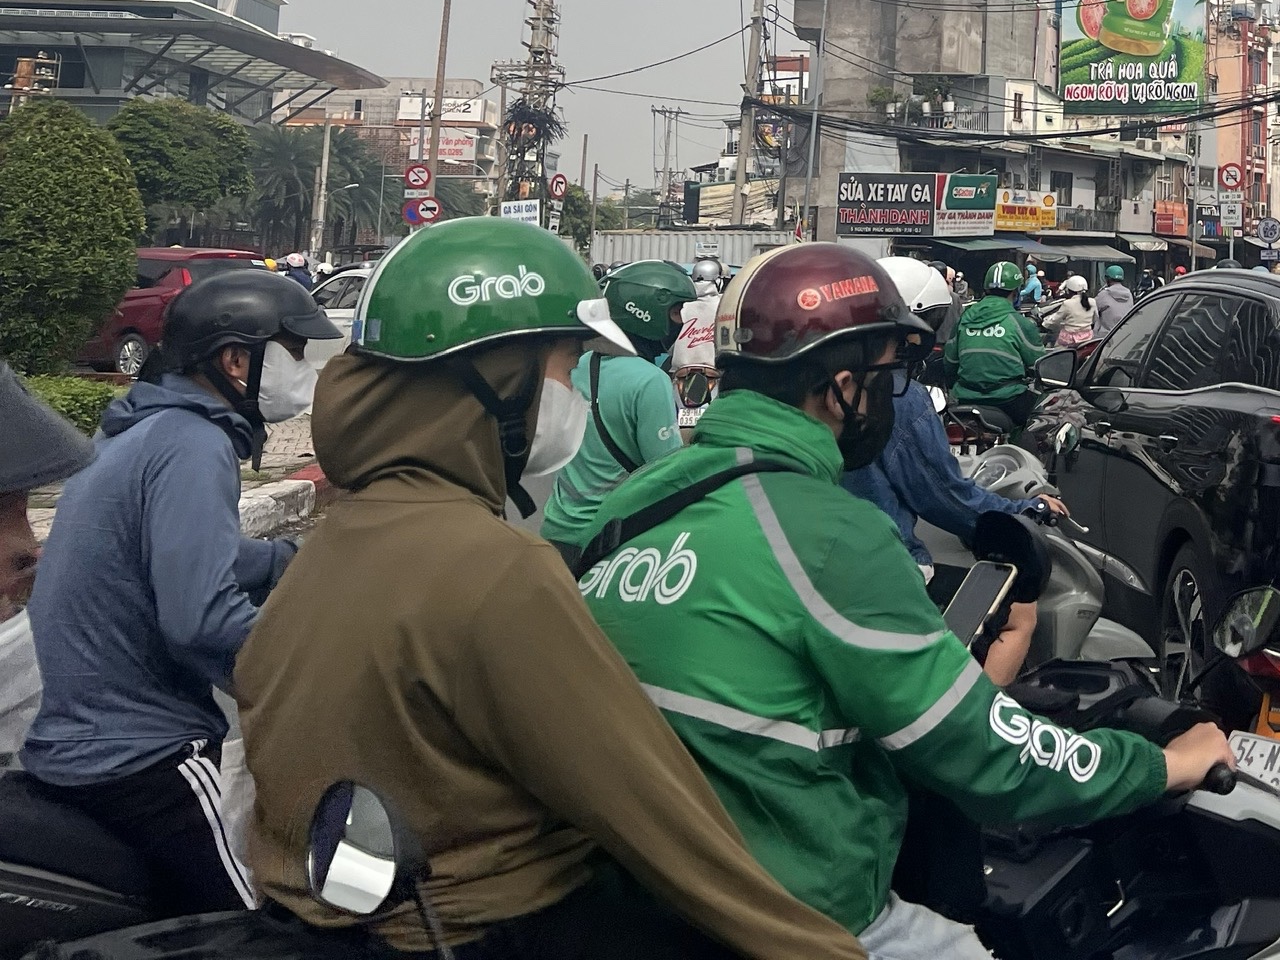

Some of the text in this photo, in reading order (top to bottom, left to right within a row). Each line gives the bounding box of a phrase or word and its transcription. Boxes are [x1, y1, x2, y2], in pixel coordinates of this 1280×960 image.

[1089, 53, 1178, 80] TRÀ HOA QUẢ
[1065, 80, 1197, 103] NGON RÕ VỊ VỊ RÕ NGON
[839, 176, 931, 203] SỬA XE TAY GA
[839, 203, 929, 225] THÀNH DANH
[447, 264, 545, 306] Grab
[819, 275, 879, 302] YAMAHA
[625, 301, 652, 323] Grab
